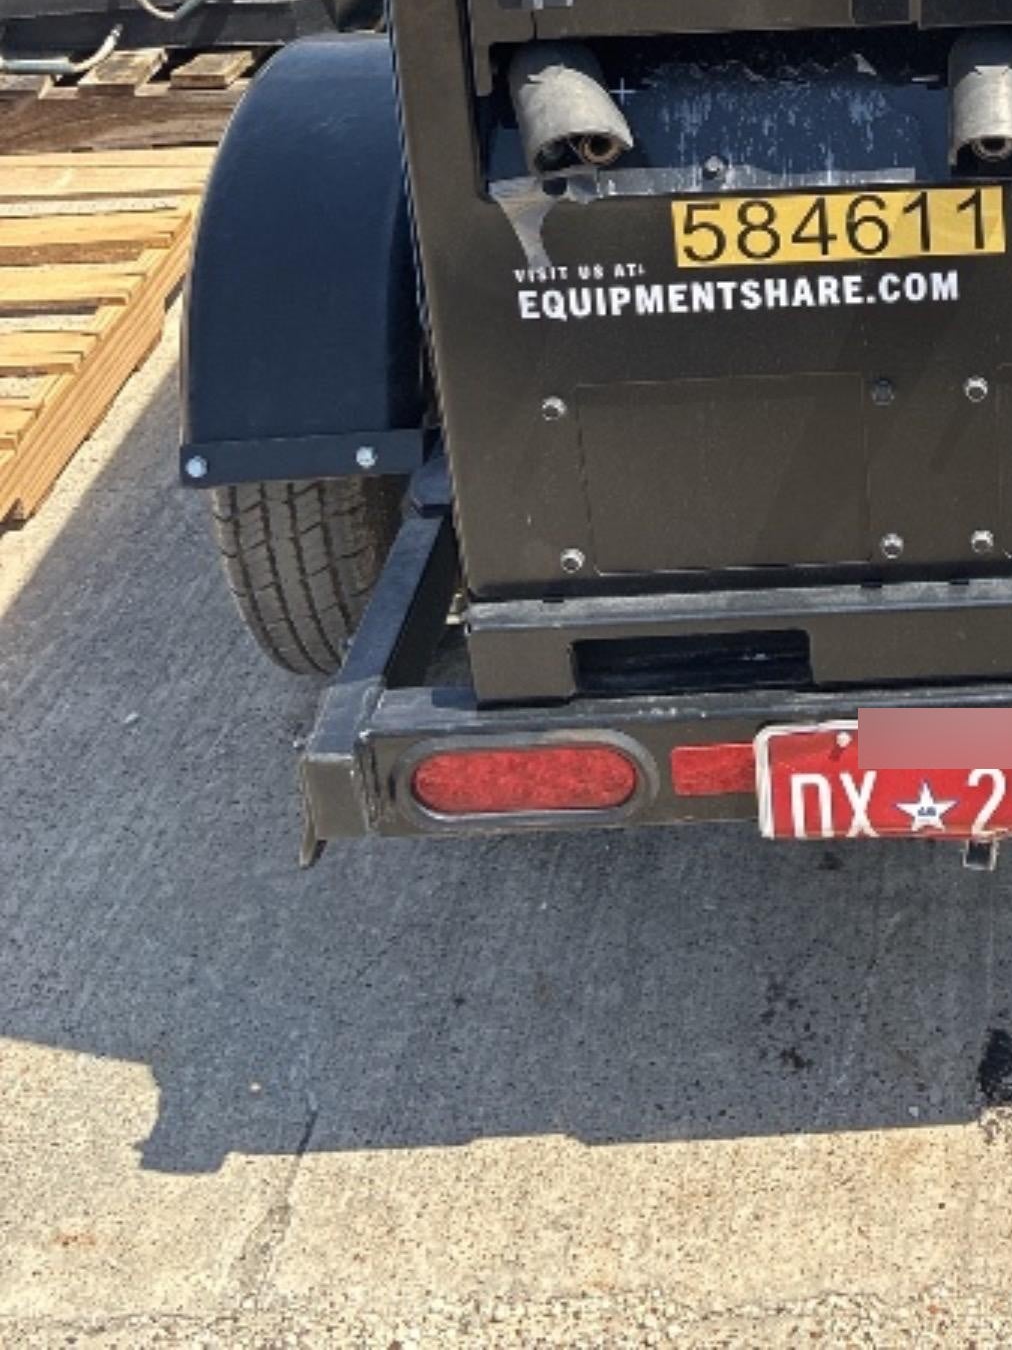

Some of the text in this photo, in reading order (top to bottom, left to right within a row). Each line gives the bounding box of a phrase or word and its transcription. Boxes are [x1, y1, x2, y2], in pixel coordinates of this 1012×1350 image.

[684, 186, 985, 263] 584611
[513, 266, 568, 283] VISIT
[578, 263, 604, 280] US
[518, 270, 960, 322] EQUIPMENTSHARE.COM
